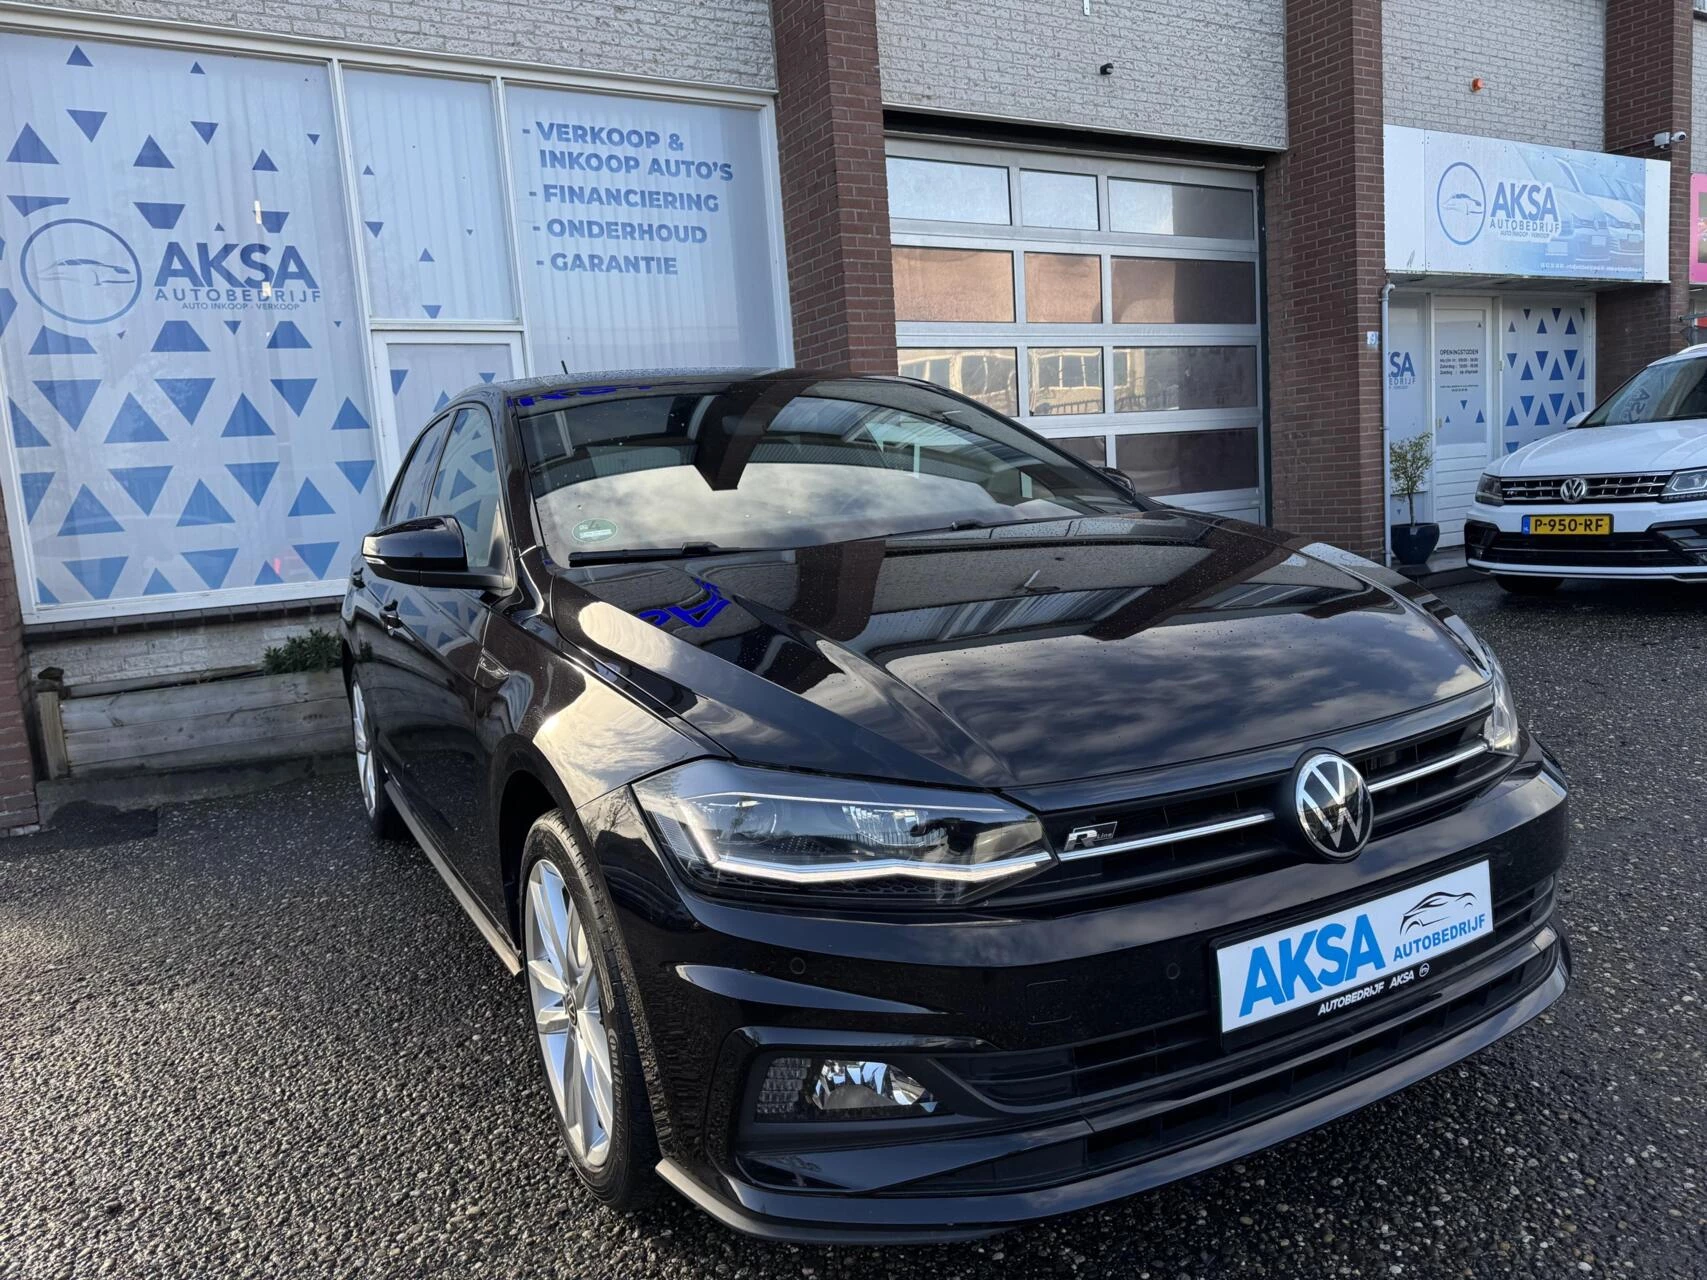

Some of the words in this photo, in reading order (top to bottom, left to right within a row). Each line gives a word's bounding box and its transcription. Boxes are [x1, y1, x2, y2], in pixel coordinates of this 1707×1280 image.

[536, 121, 660, 148] VERKOOP
[668, 133, 684, 151] &
[540, 150, 640, 174] INKOOP
[648, 157, 733, 181] AUTO'S
[543, 184, 719, 213] FINANCIERING
[1490, 182, 1558, 222] AKSA
[547, 218, 707, 244] ONDERHOUD
[1489, 218, 1560, 233] AUTOBEDRIJF
[154, 242, 319, 289] AKSA
[550, 252, 678, 275] GARANTIE
[155, 288, 320, 303] AUTOBEDRIJF
[182, 302, 208, 310] AUTO
[256, 303, 299, 311] VERKOOP
[1388, 351, 1415, 378] SA
[1534, 518, 1604, 532] P-950-RF
[1393, 913, 1486, 962] AUTOBEDRIJF
[1239, 914, 1386, 1017] AKSA
[1318, 981, 1385, 1016] AUTOBEDRIJF
[1389, 970, 1415, 989] AKSA
